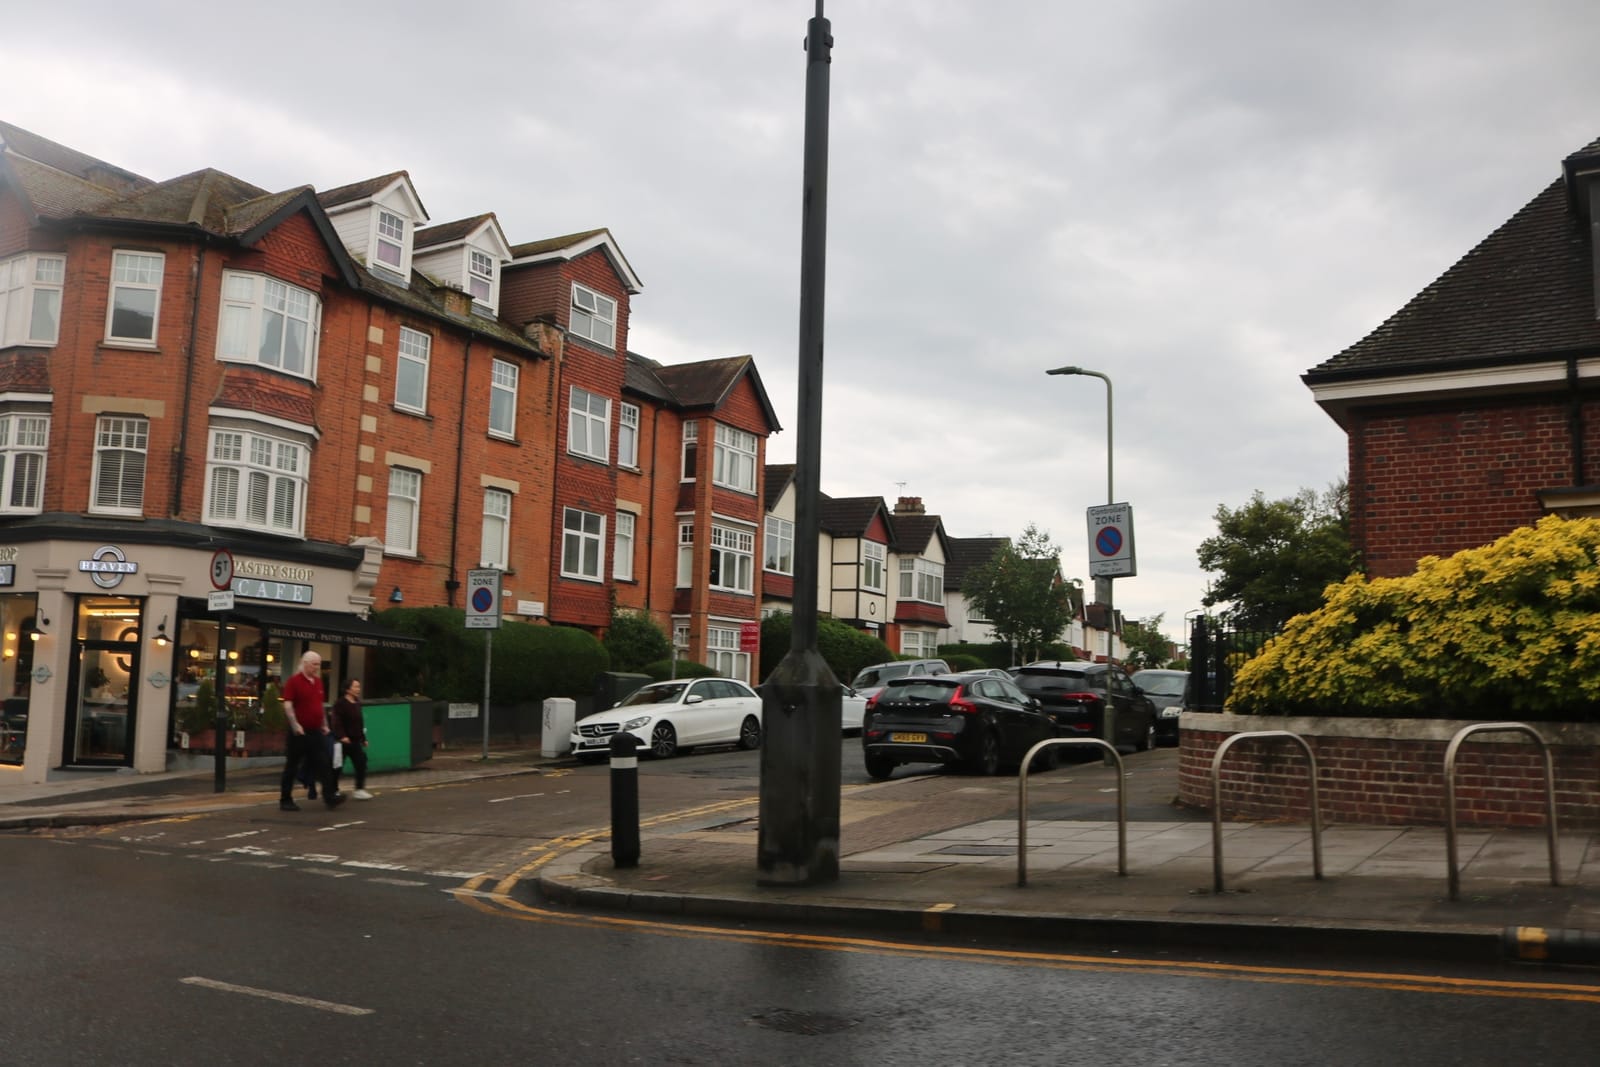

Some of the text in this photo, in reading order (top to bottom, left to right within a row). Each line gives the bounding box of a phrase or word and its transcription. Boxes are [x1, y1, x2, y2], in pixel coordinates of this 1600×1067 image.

[1095, 514, 1121, 526] ZONE
[82, 561, 135, 572] HEAVEN
[215, 560, 228, 578] 5T
[281, 566, 314, 581] SHOP
[473, 578, 494, 586] ZONE
[238, 579, 304, 602] CAFE
